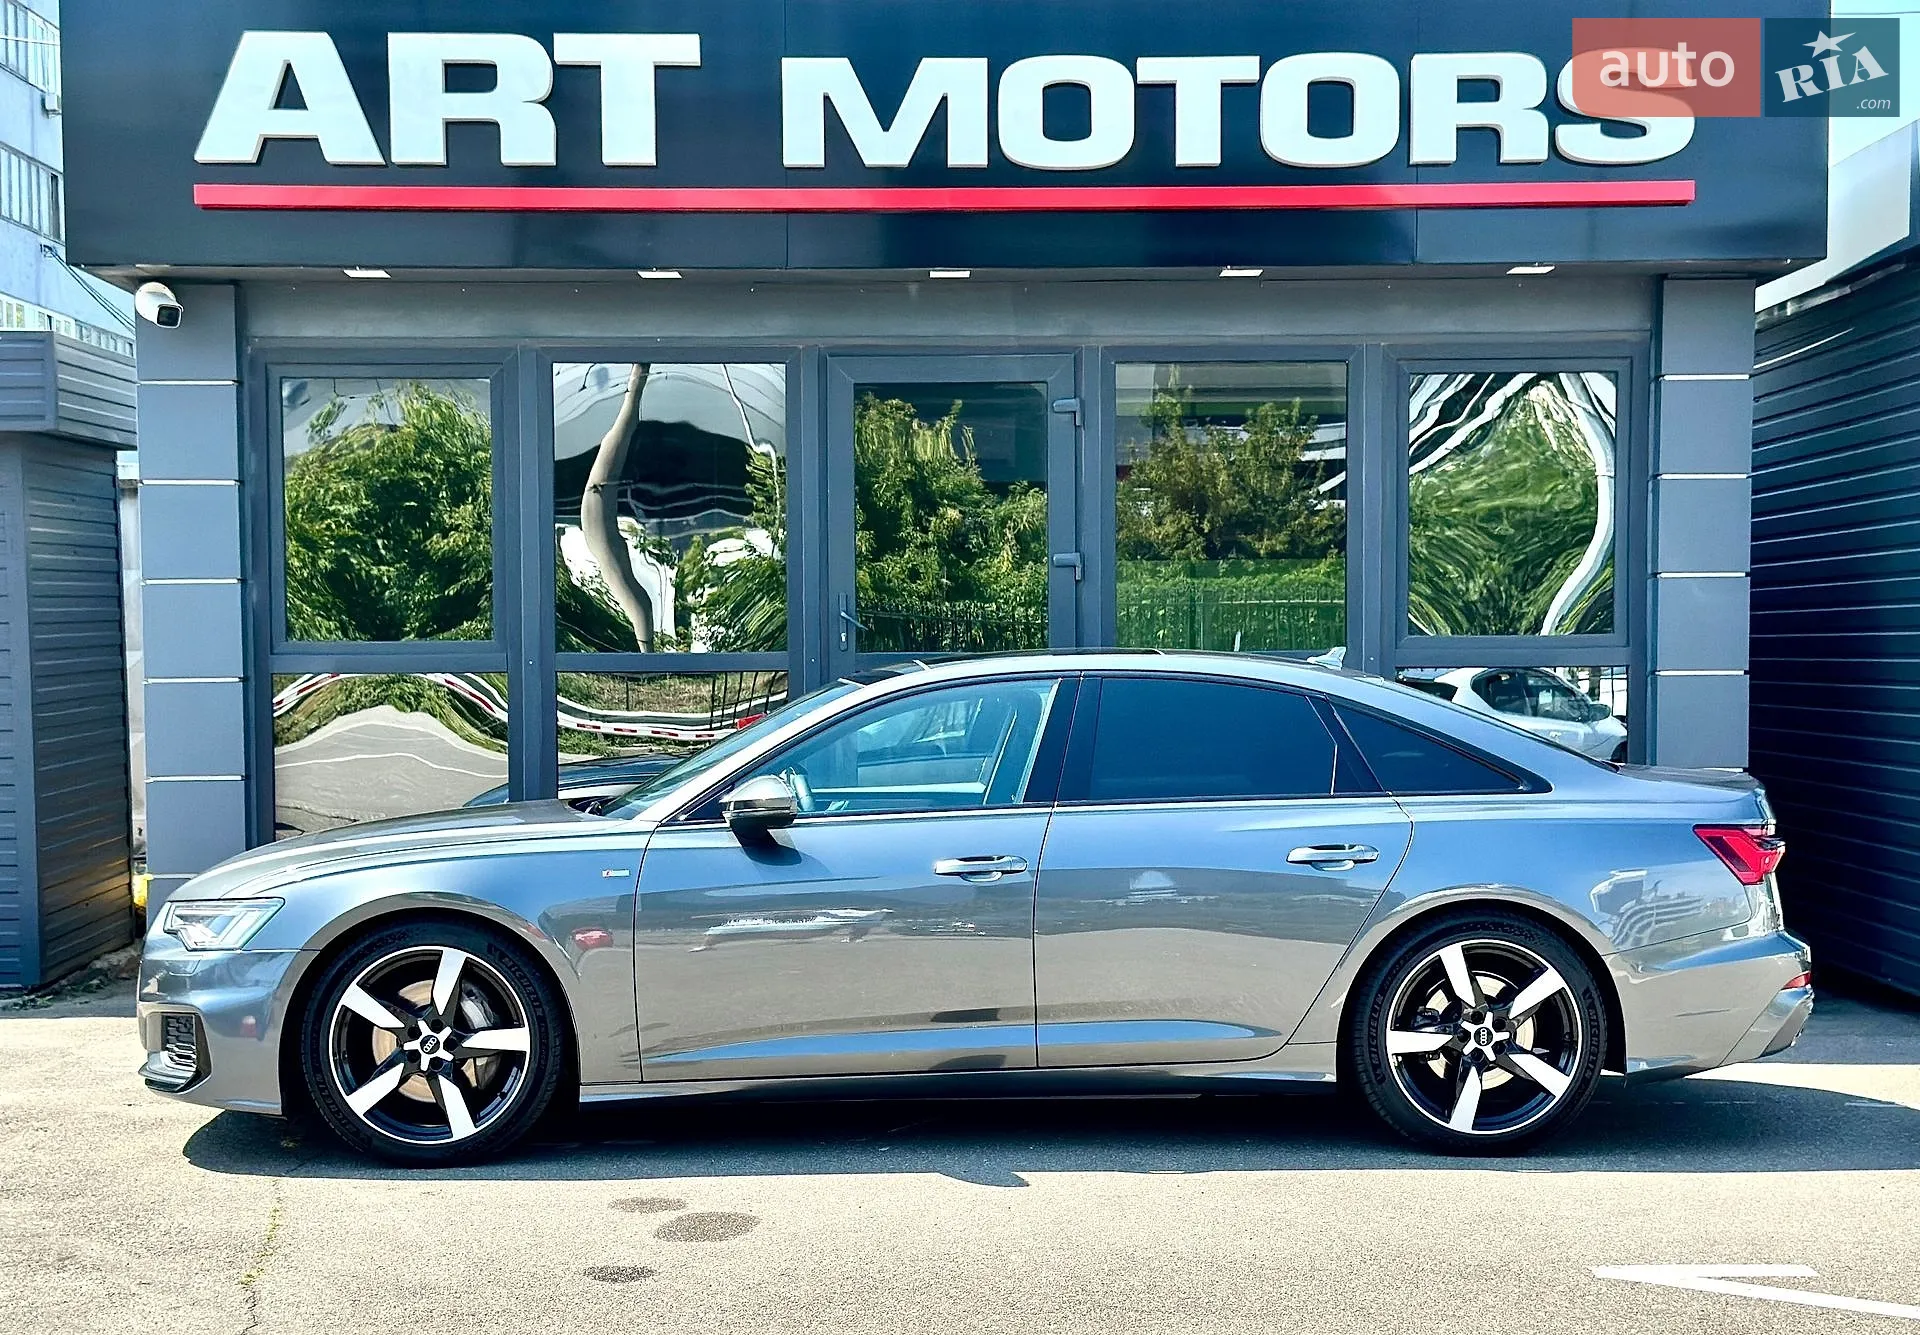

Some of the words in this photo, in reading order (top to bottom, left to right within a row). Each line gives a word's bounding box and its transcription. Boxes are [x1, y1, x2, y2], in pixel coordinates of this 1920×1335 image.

[194, 30, 701, 166] ART
[781, 47, 1696, 171] MOTORS
[1369, 993, 1384, 1065] MICHELIN
[1585, 1008, 1599, 1079] MICHELIN
